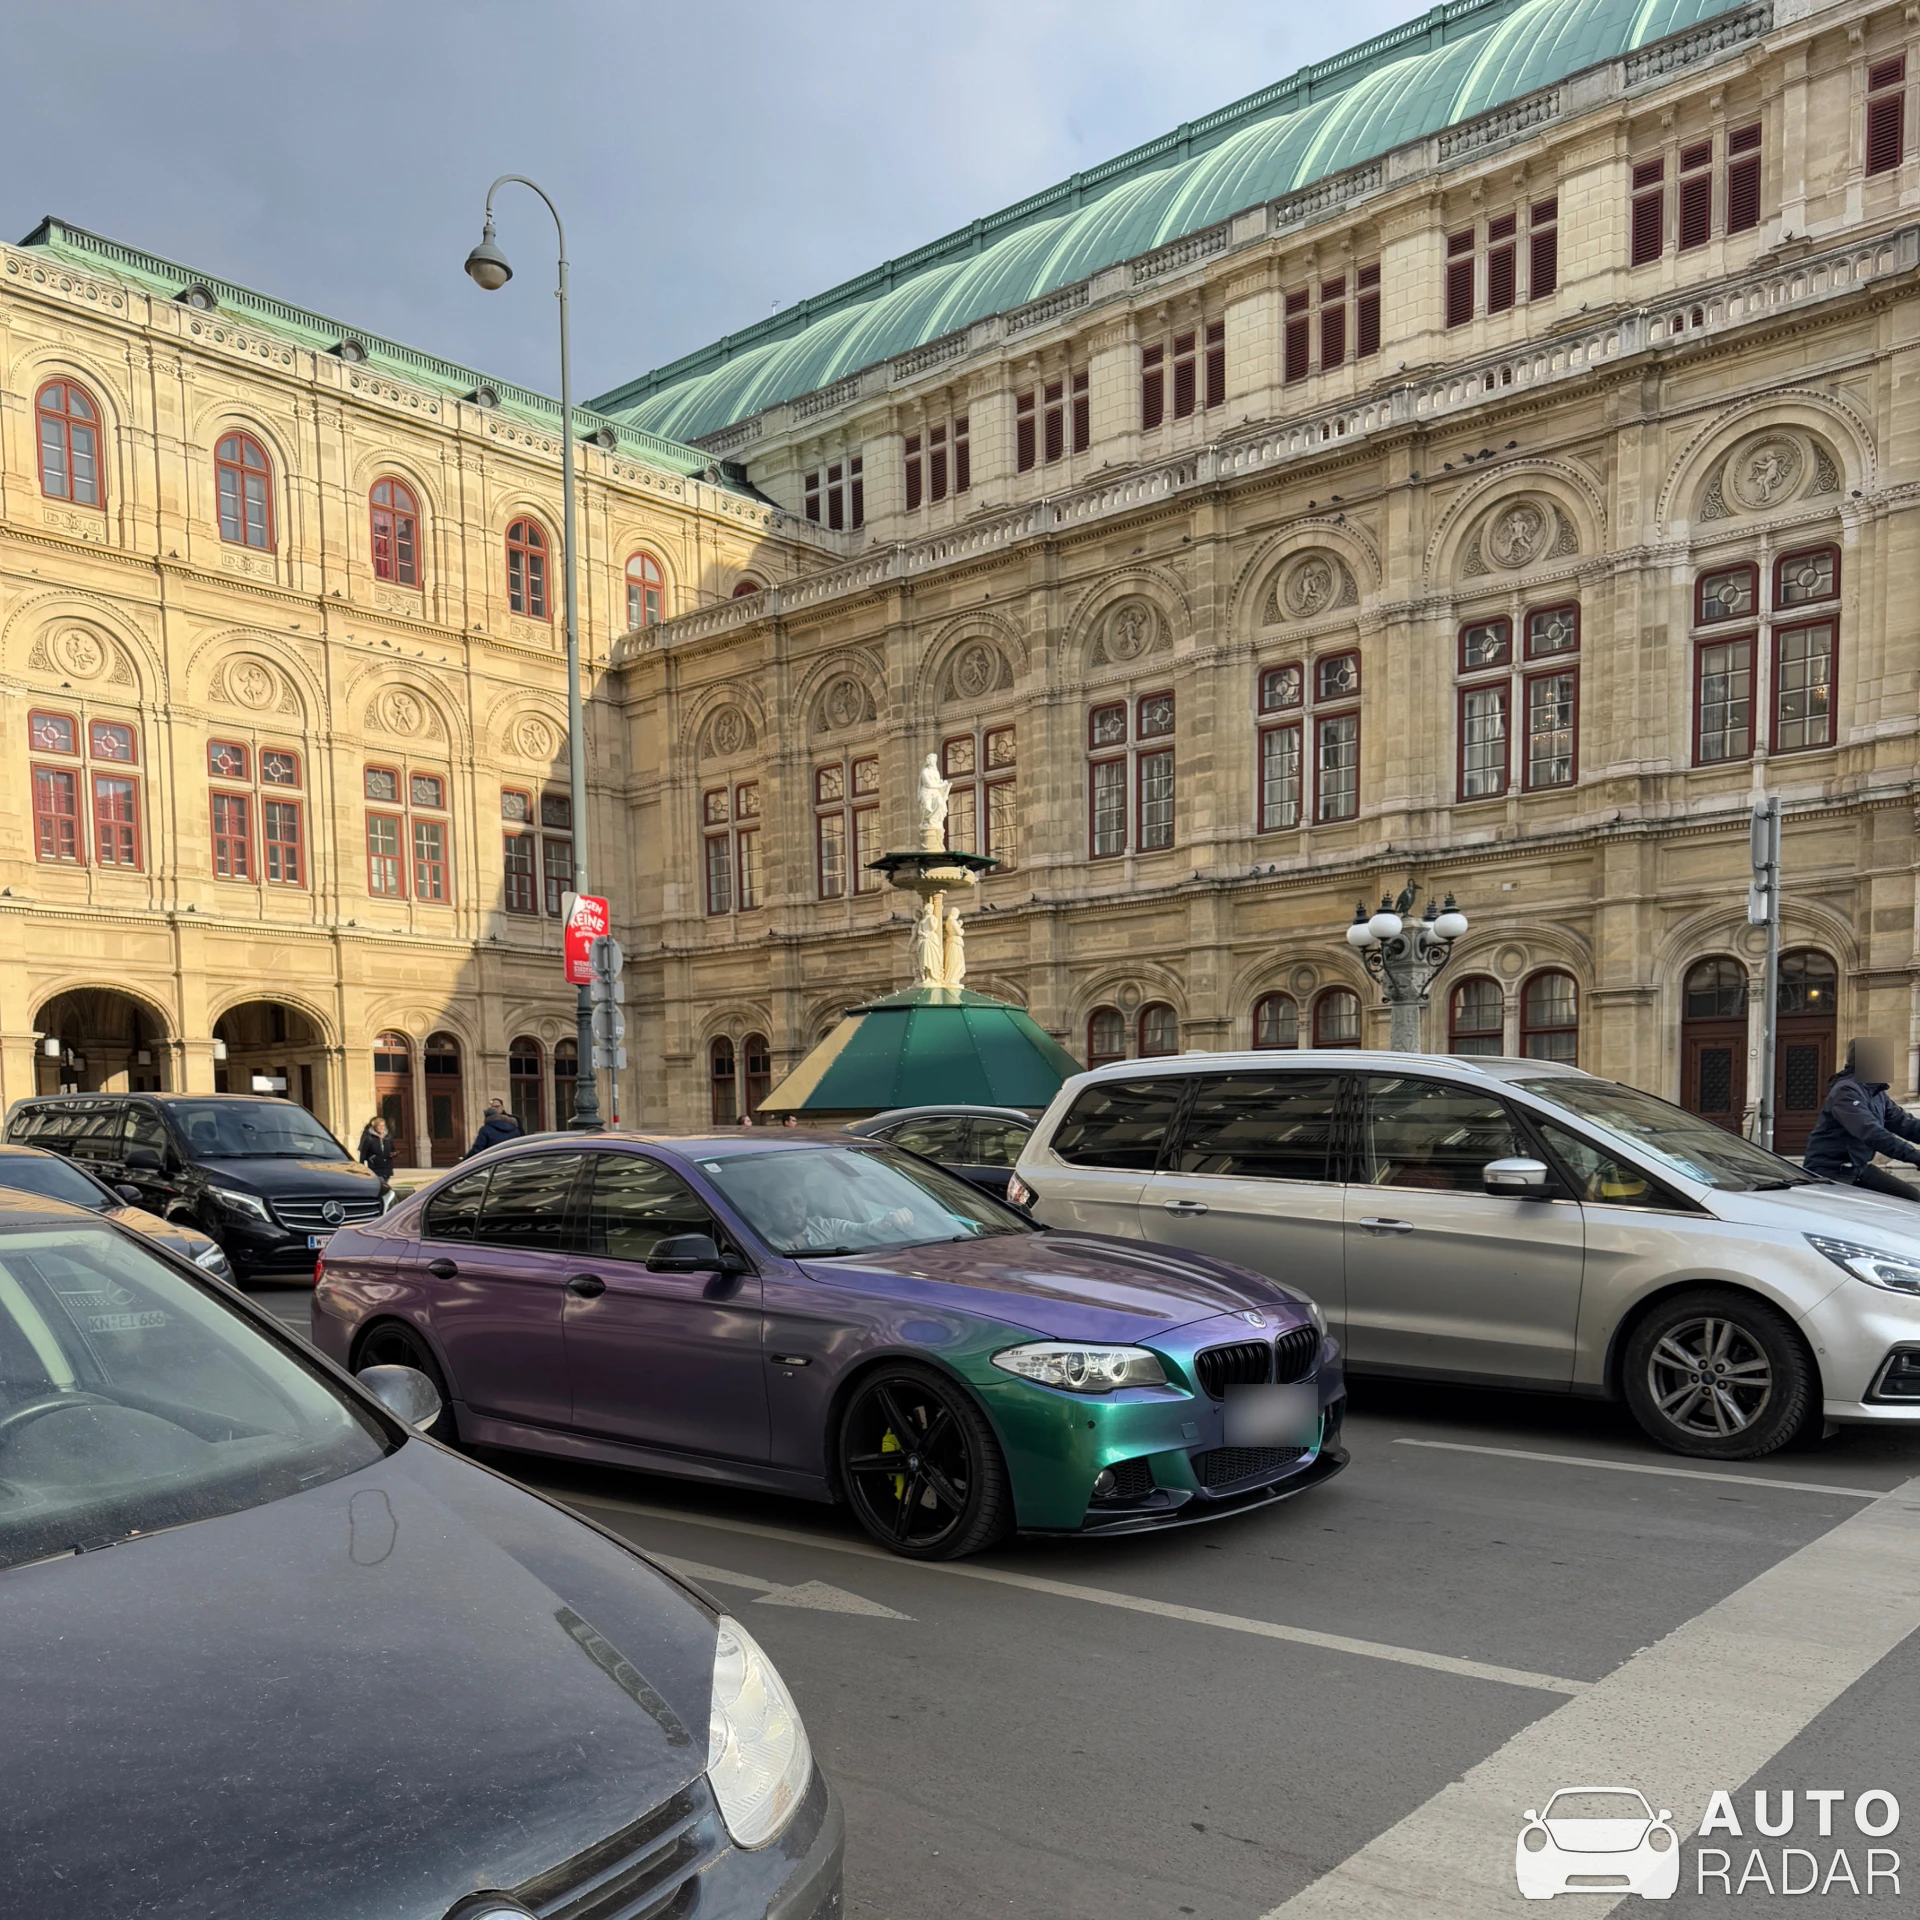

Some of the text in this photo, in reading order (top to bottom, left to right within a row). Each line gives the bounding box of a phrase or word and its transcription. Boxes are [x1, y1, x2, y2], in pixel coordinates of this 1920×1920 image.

[570, 912, 605, 932] KEINE
[90, 1316, 110, 1331] KN
[140, 1312, 163, 1326] 666
